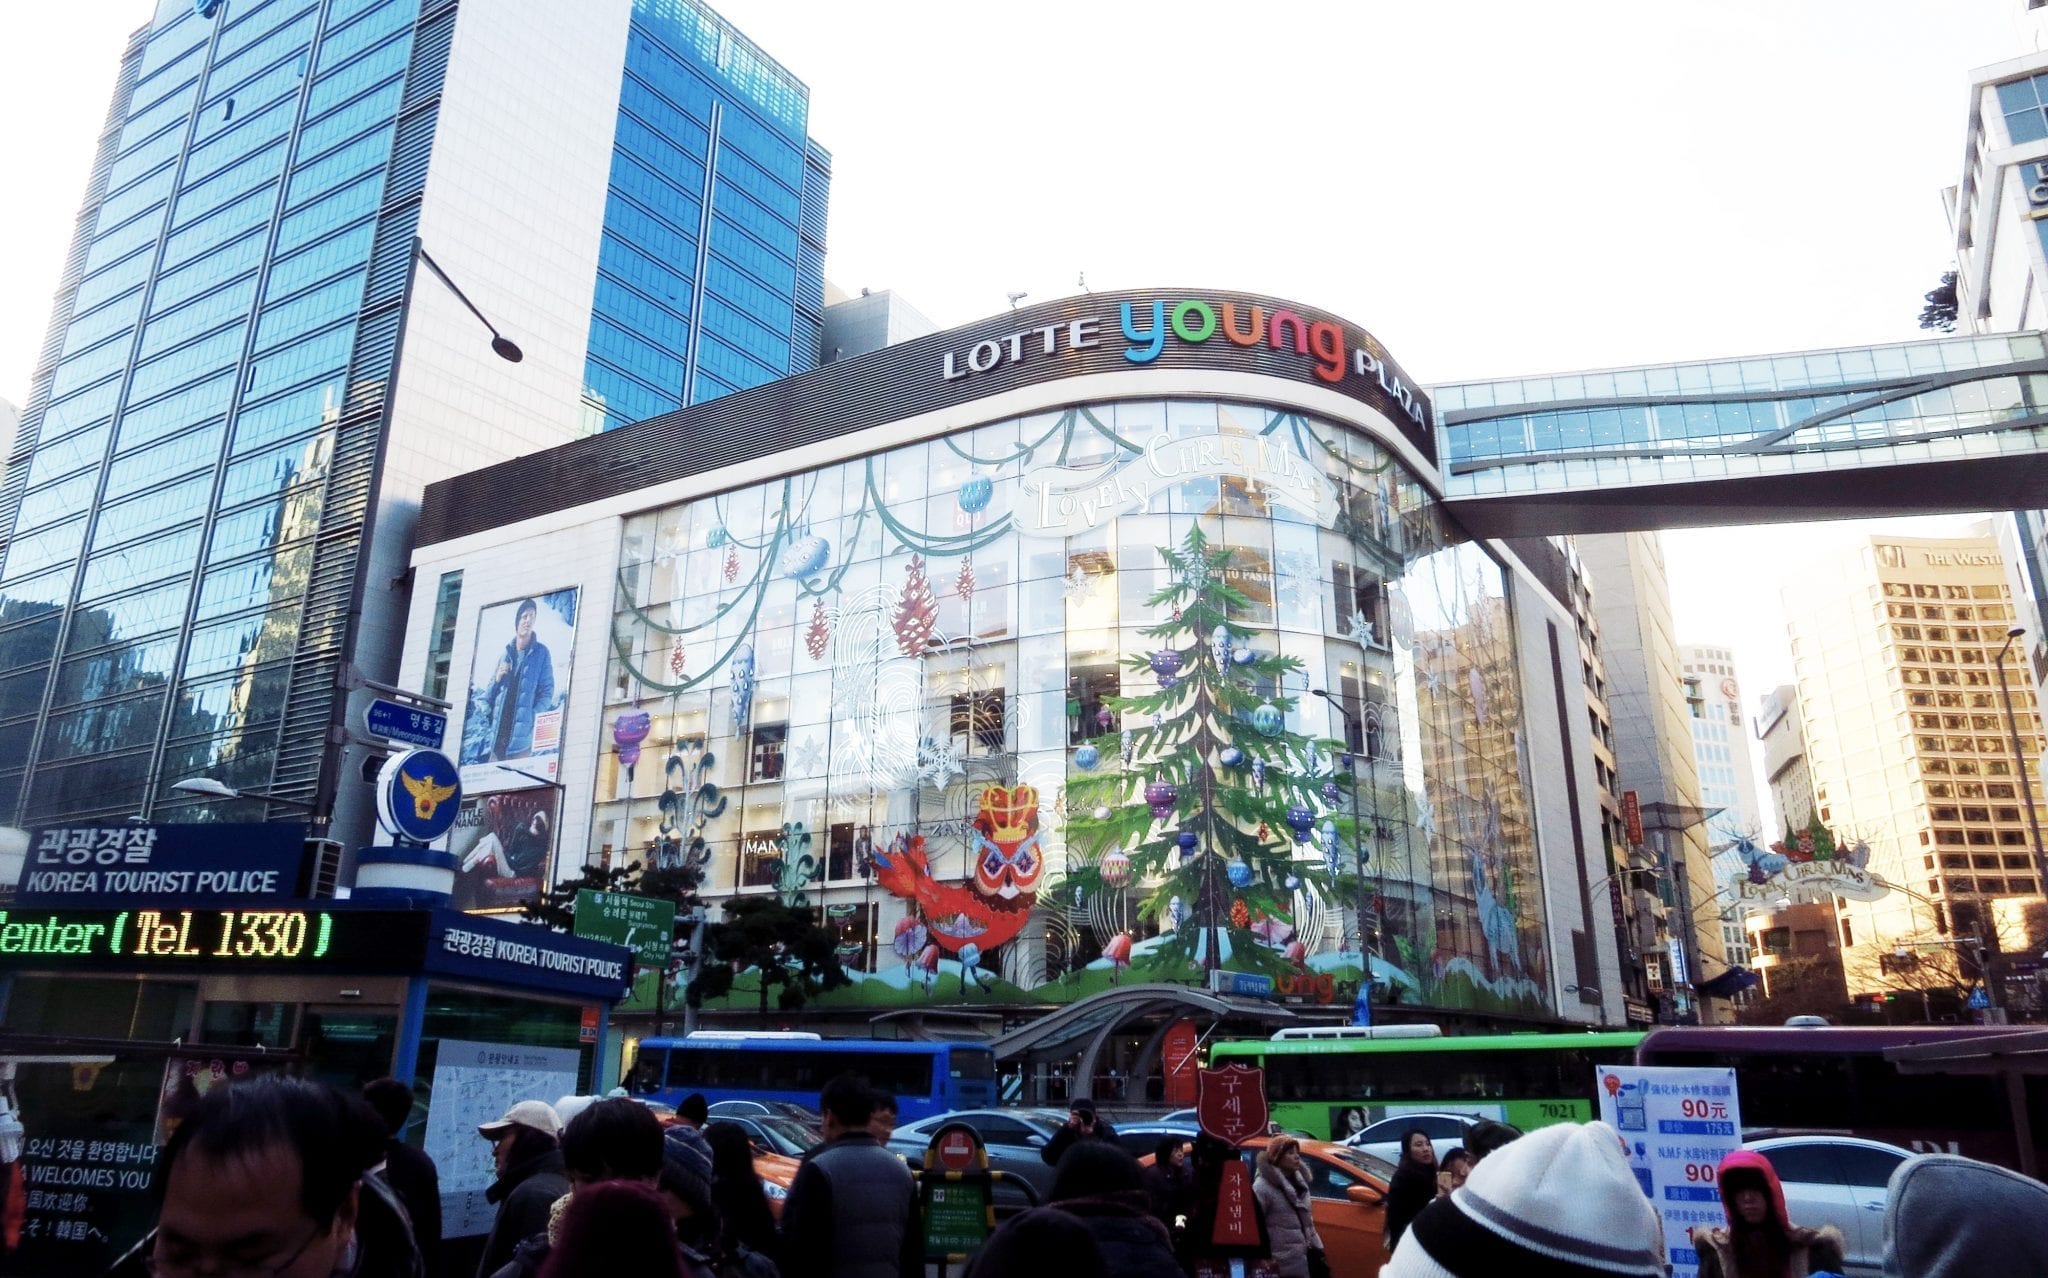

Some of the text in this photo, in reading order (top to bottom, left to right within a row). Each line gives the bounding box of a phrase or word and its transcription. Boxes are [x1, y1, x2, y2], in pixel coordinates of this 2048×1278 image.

[943, 299, 1425, 432] LOTTE young PLAZA
[1924, 552, 2003, 567] THE WESTI
[410, 713, 444, 734] 명동길
[37, 828, 157, 865] 관광경찰
[26, 870, 279, 893] KOREA TOURIST POLICE
[213, 912, 307, 956] 1330
[444, 928, 496, 959] 관광경찰
[496, 940, 622, 980] KOREA TOURIST POLICE
[1220, 1075, 1246, 1136] 구세군
[1539, 1104, 1577, 1119] 7021
[26, 1138, 55, 1159] 오신
[57, 1139, 85, 1161] 것을
[87, 1141, 158, 1165] 환영합니다
[31, 1164, 115, 1188] WELCOMES
[118, 1170, 151, 1190] YOU
[24, 1190, 94, 1213] 国欢迎你。
[1228, 1172, 1242, 1235] 자선냄비
